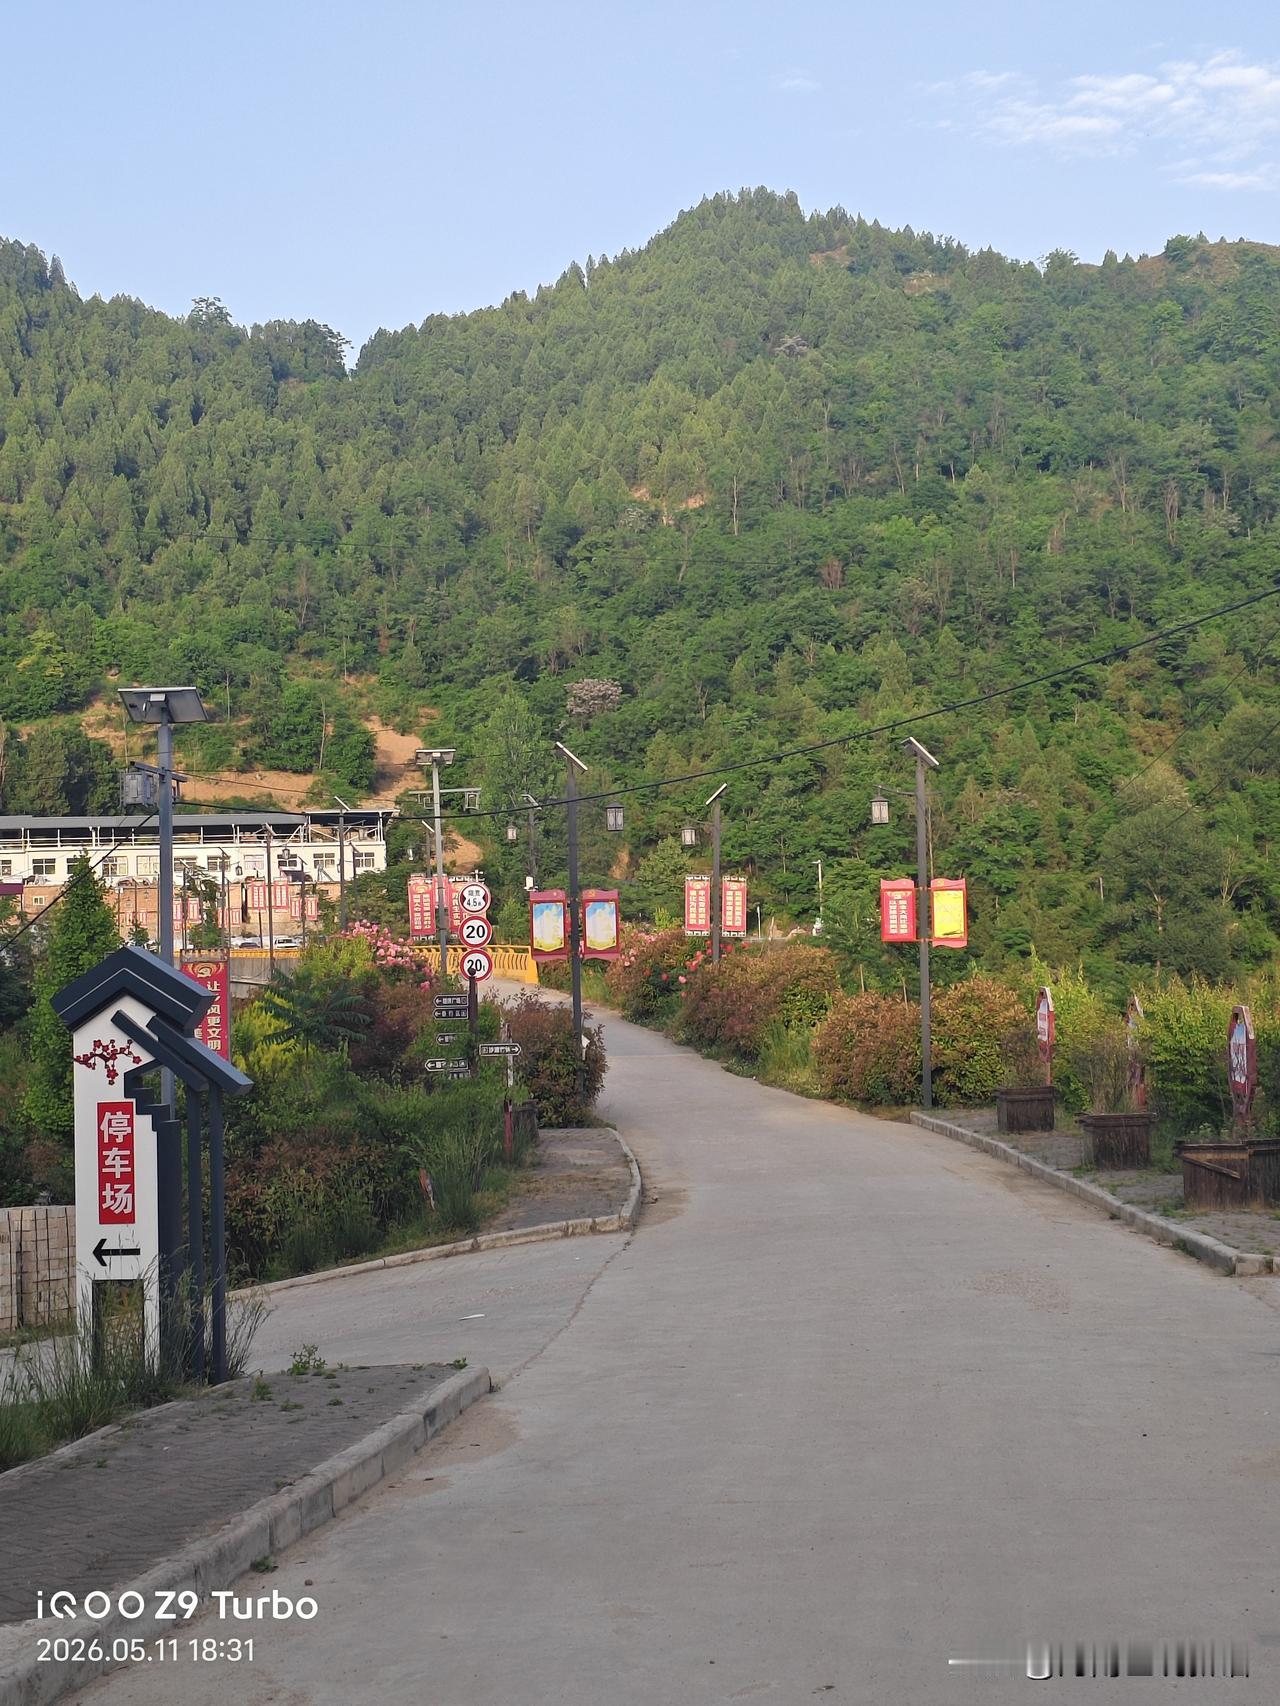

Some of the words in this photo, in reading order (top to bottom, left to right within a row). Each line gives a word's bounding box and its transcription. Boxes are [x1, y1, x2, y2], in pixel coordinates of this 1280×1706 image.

[466, 925, 486, 939] 20
[99, 1111, 133, 1215] 停车场
